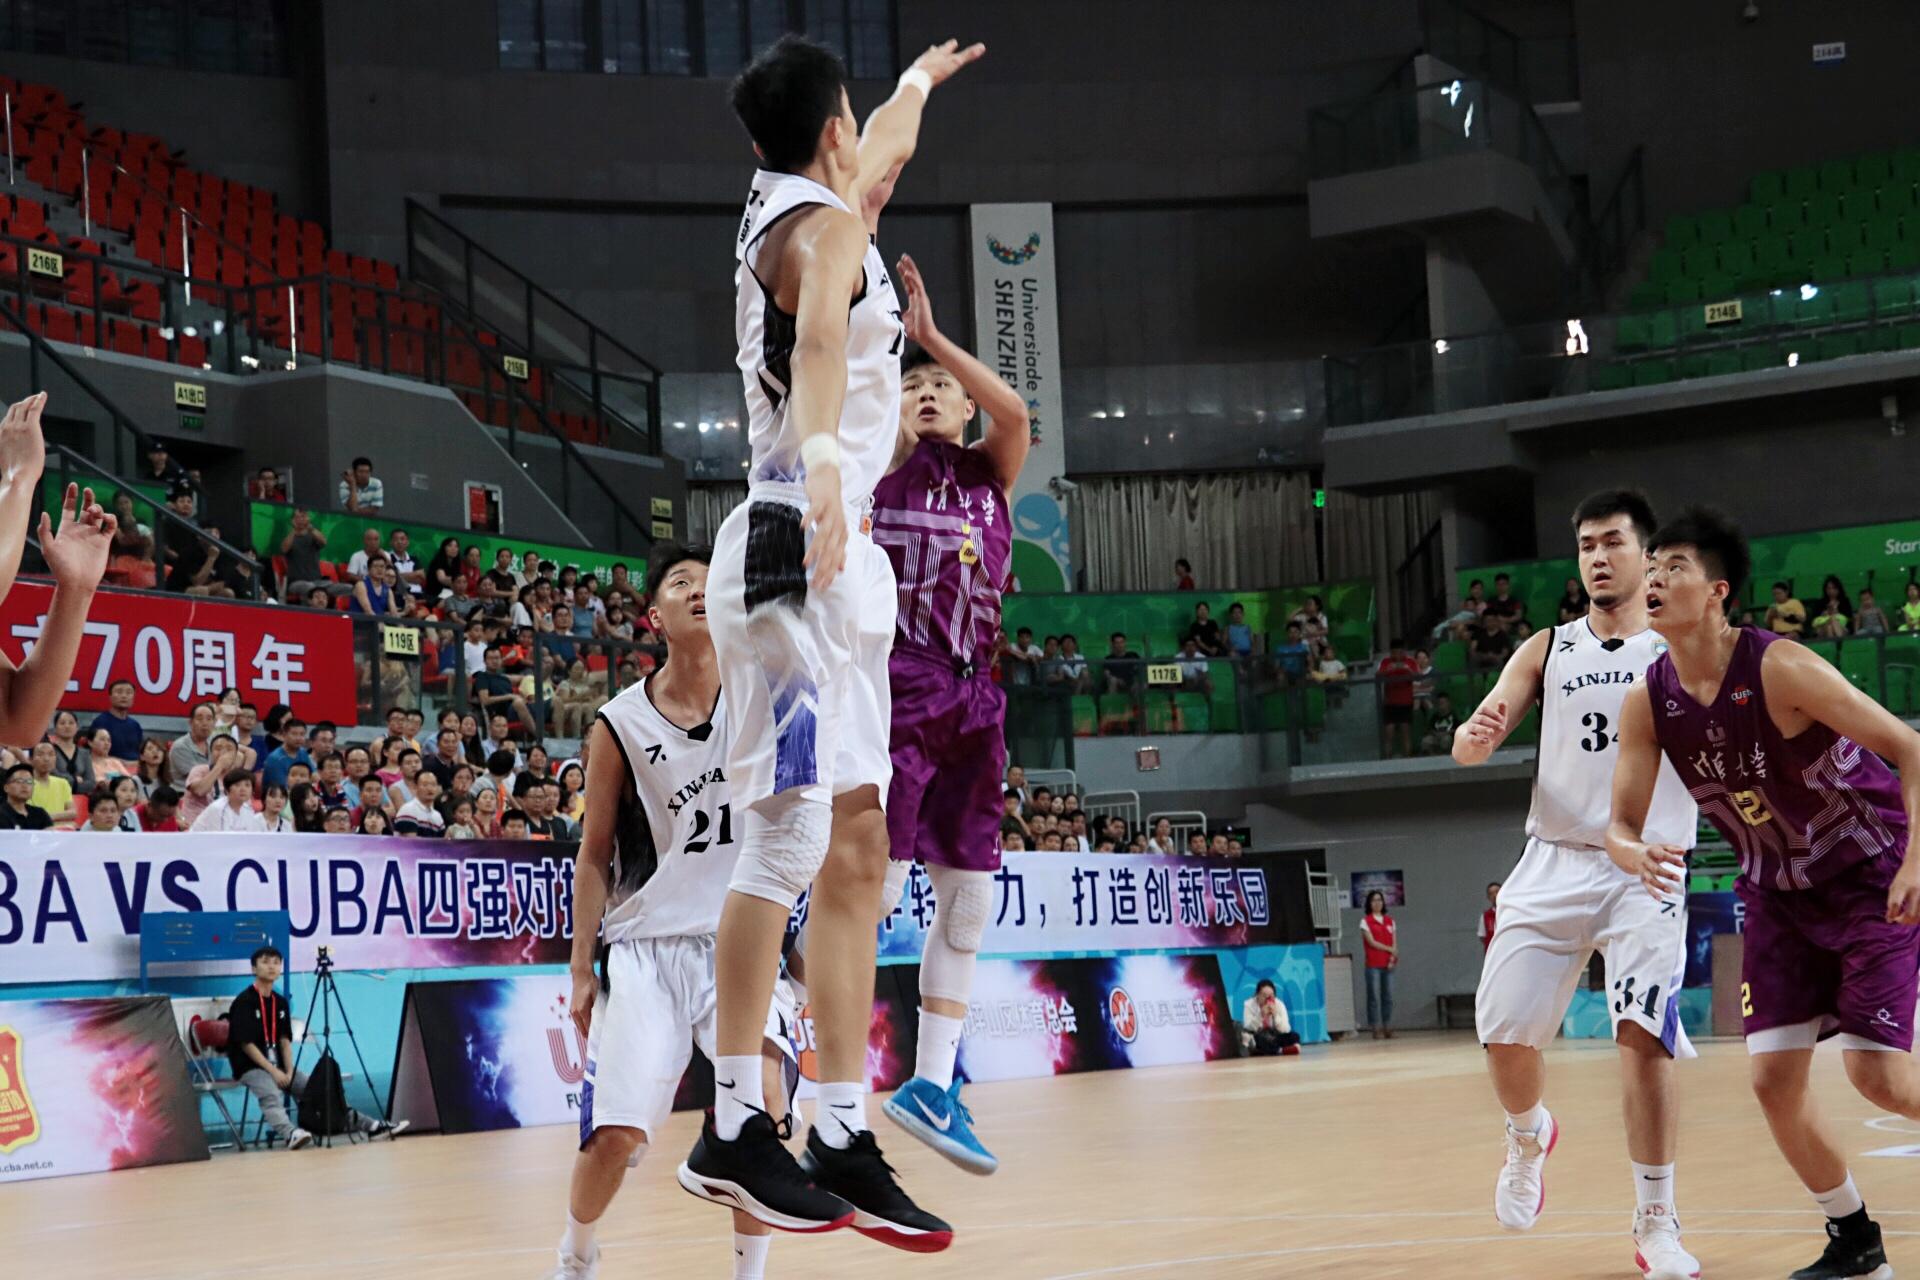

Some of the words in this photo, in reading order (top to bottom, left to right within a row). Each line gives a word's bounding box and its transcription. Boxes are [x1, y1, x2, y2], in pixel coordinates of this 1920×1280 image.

[32, 253, 59, 273] 216区
[1709, 304, 1738, 320] 214区
[994, 279, 1018, 391] SHENZHE
[1021, 278, 1042, 391] Universiade
[177, 386, 204, 404] A1出口
[1885, 538, 1920, 555] Star
[389, 632, 415, 651] 119区
[1151, 668, 1178, 681] 117区
[1561, 671, 1636, 697] XINJIA
[667, 767, 728, 817] XINJIA
[683, 802, 734, 854] 21
[104, 858, 204, 936] VS
[0, 1160, 53, 1174] .cba.net.cn
